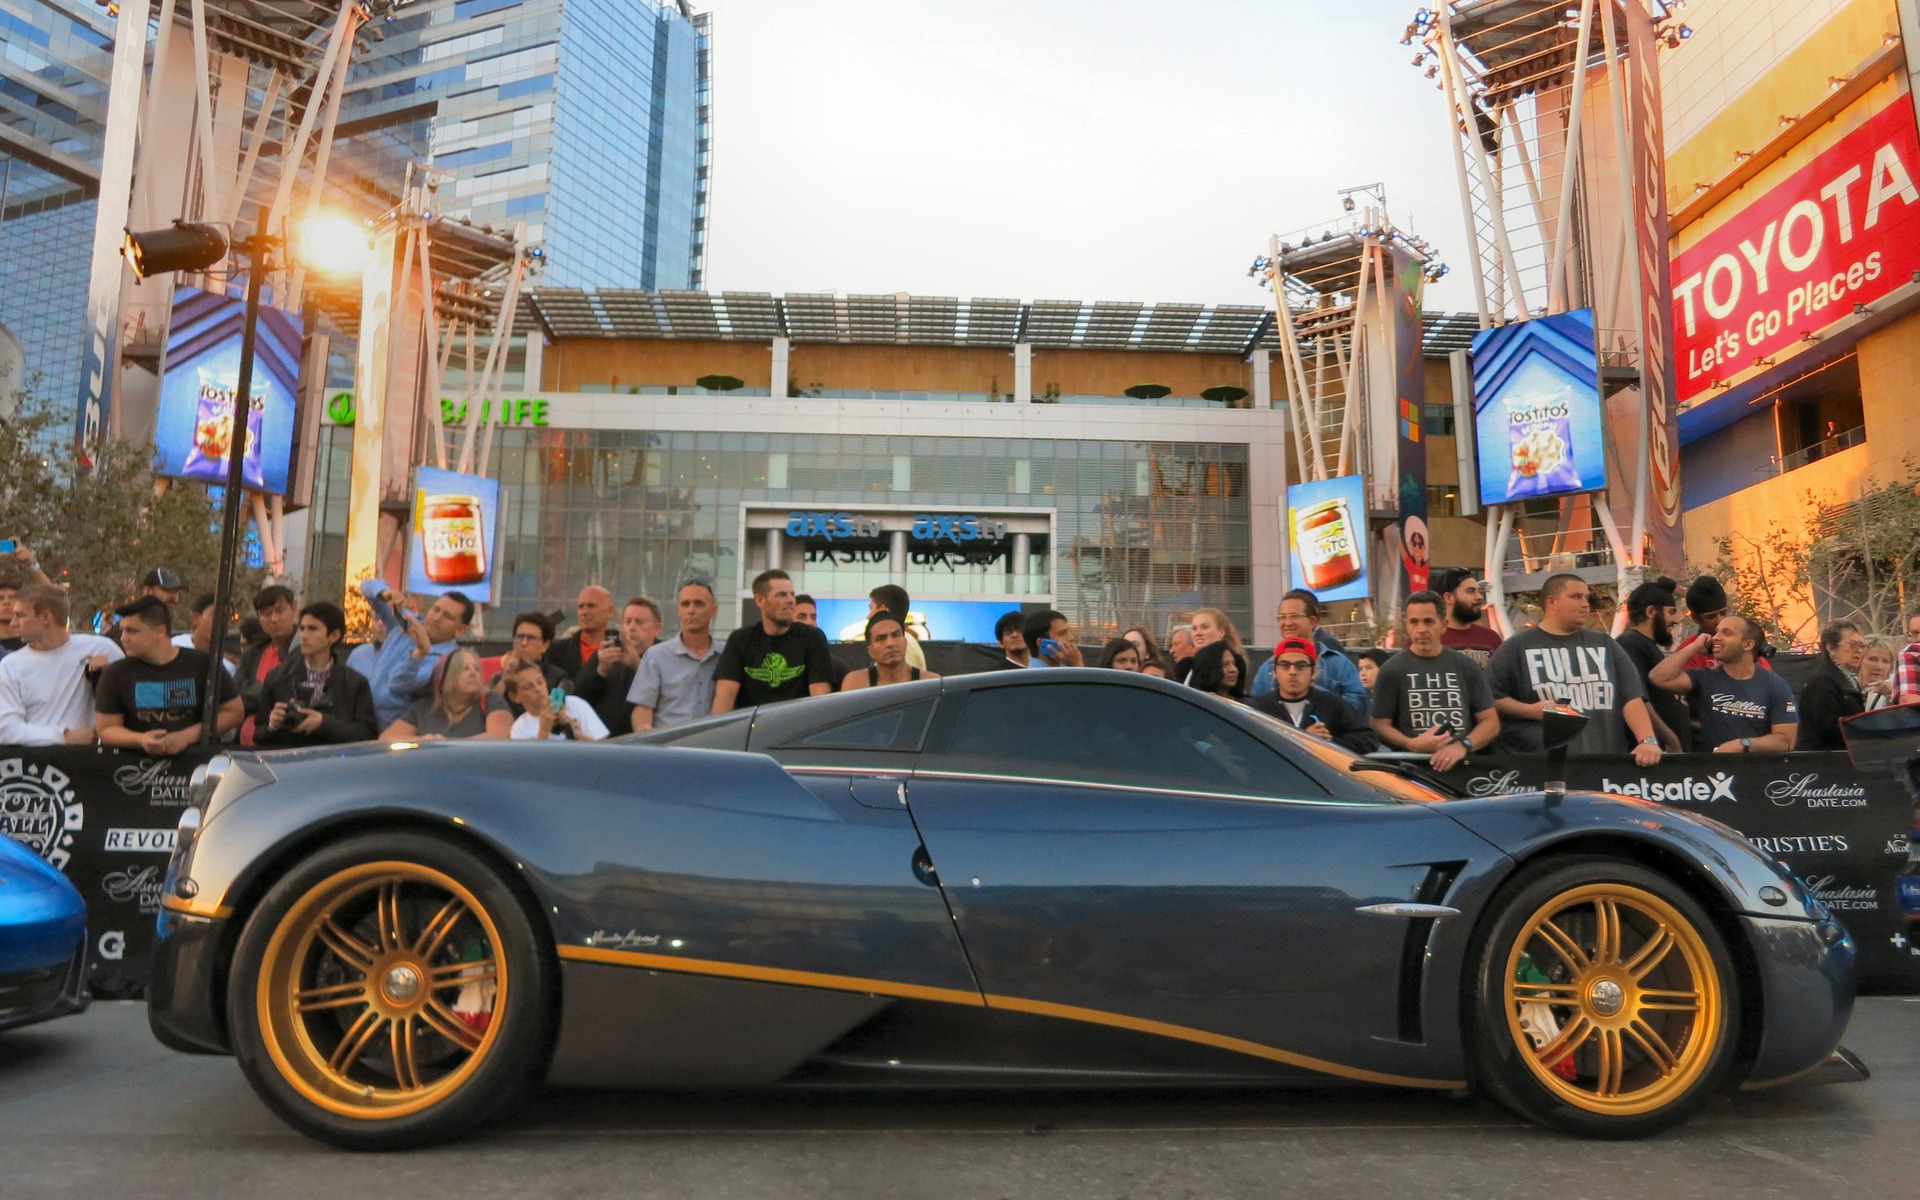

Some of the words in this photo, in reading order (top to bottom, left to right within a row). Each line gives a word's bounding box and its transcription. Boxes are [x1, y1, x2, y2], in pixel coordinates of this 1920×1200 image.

[1637, 37, 1661, 299] LIGHT
[1672, 142, 1919, 338] TOYOTA
[1688, 329, 1740, 380] Let's
[1746, 309, 1781, 346] Go
[1787, 251, 1882, 327] Places
[1649, 294, 1673, 491] BUD
[1407, 672, 1459, 689] THE
[1525, 646, 1609, 685] FULLY
[1408, 691, 1462, 709] BER
[1410, 710, 1465, 728] RICS
[1602, 777, 1710, 802] betsafe
[1764, 773, 1866, 807] Anastasia
[1807, 798, 1867, 808] DATE.COM
